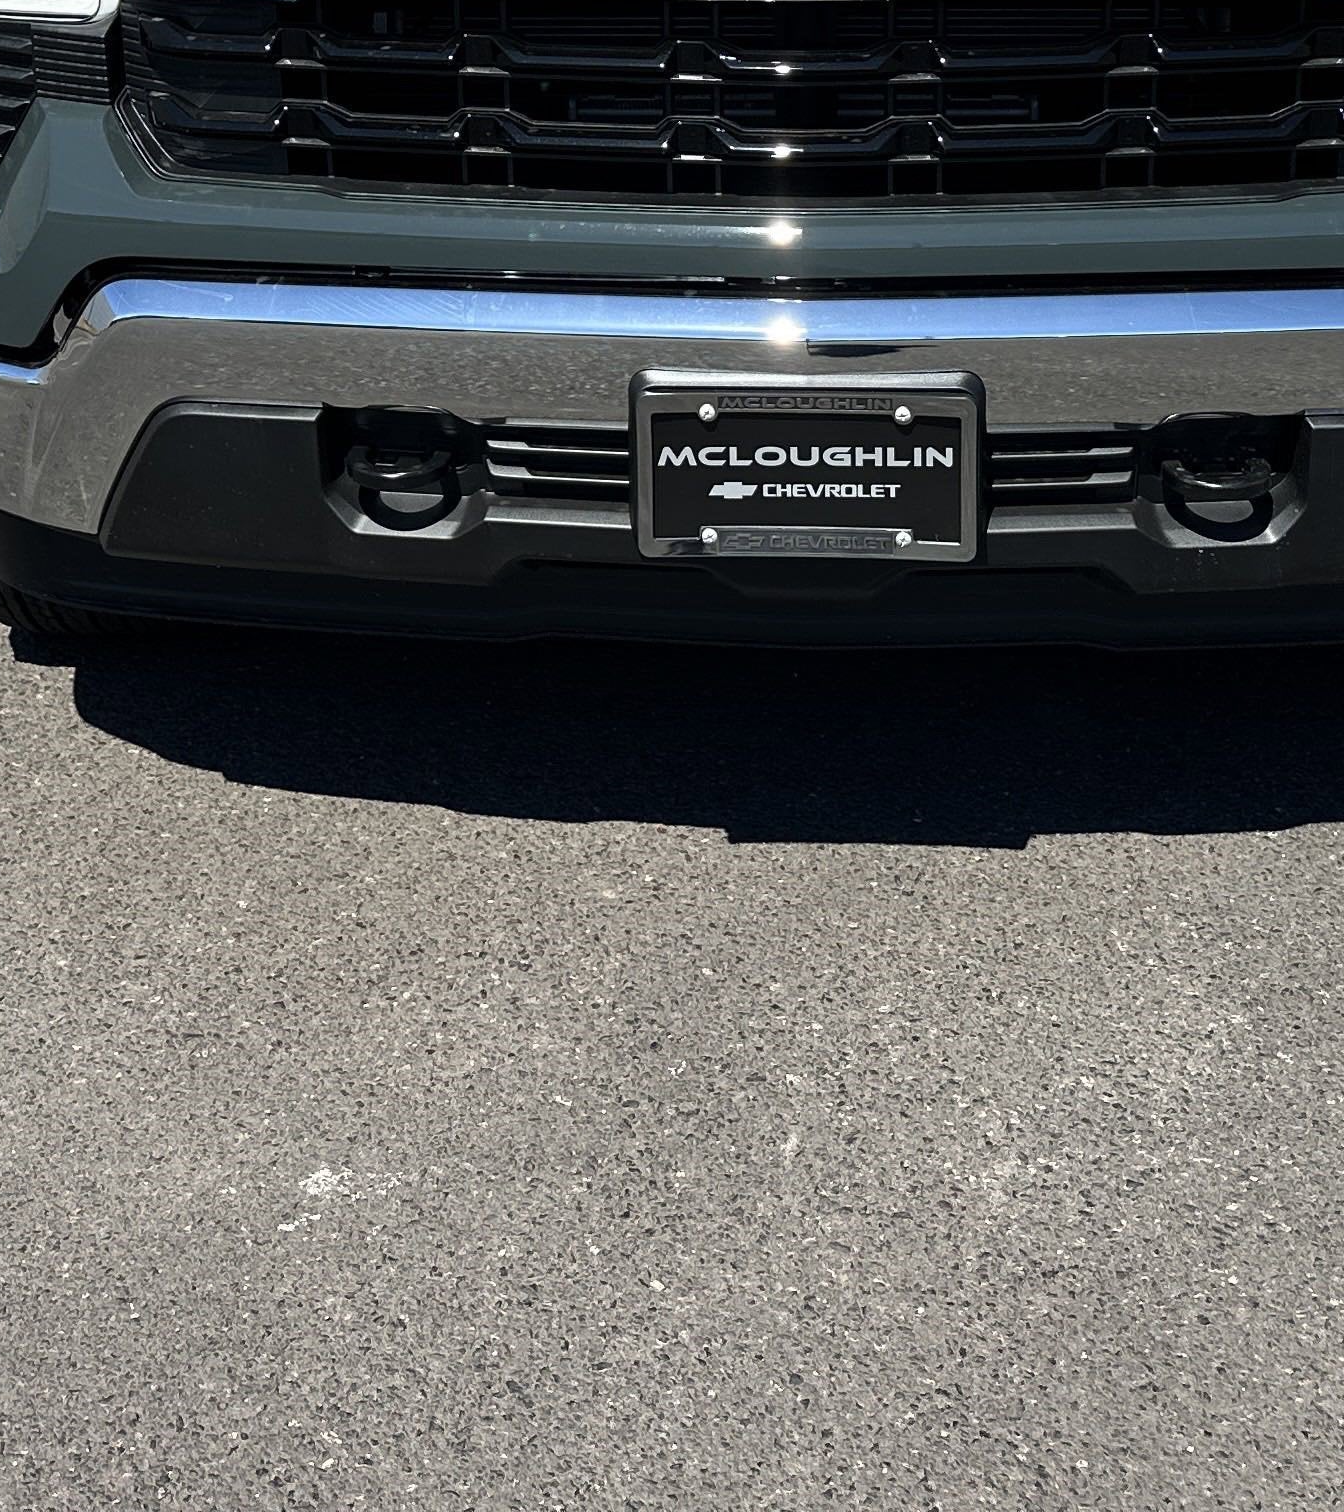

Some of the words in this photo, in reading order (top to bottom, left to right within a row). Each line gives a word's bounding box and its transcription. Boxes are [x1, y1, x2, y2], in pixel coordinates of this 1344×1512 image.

[720, 396, 892, 410] MCLOUGHLIN
[657, 446, 954, 468] MCLOUGHLIN
[762, 483, 902, 498] CHEVROLET
[769, 534, 892, 550] CHEVROLET
